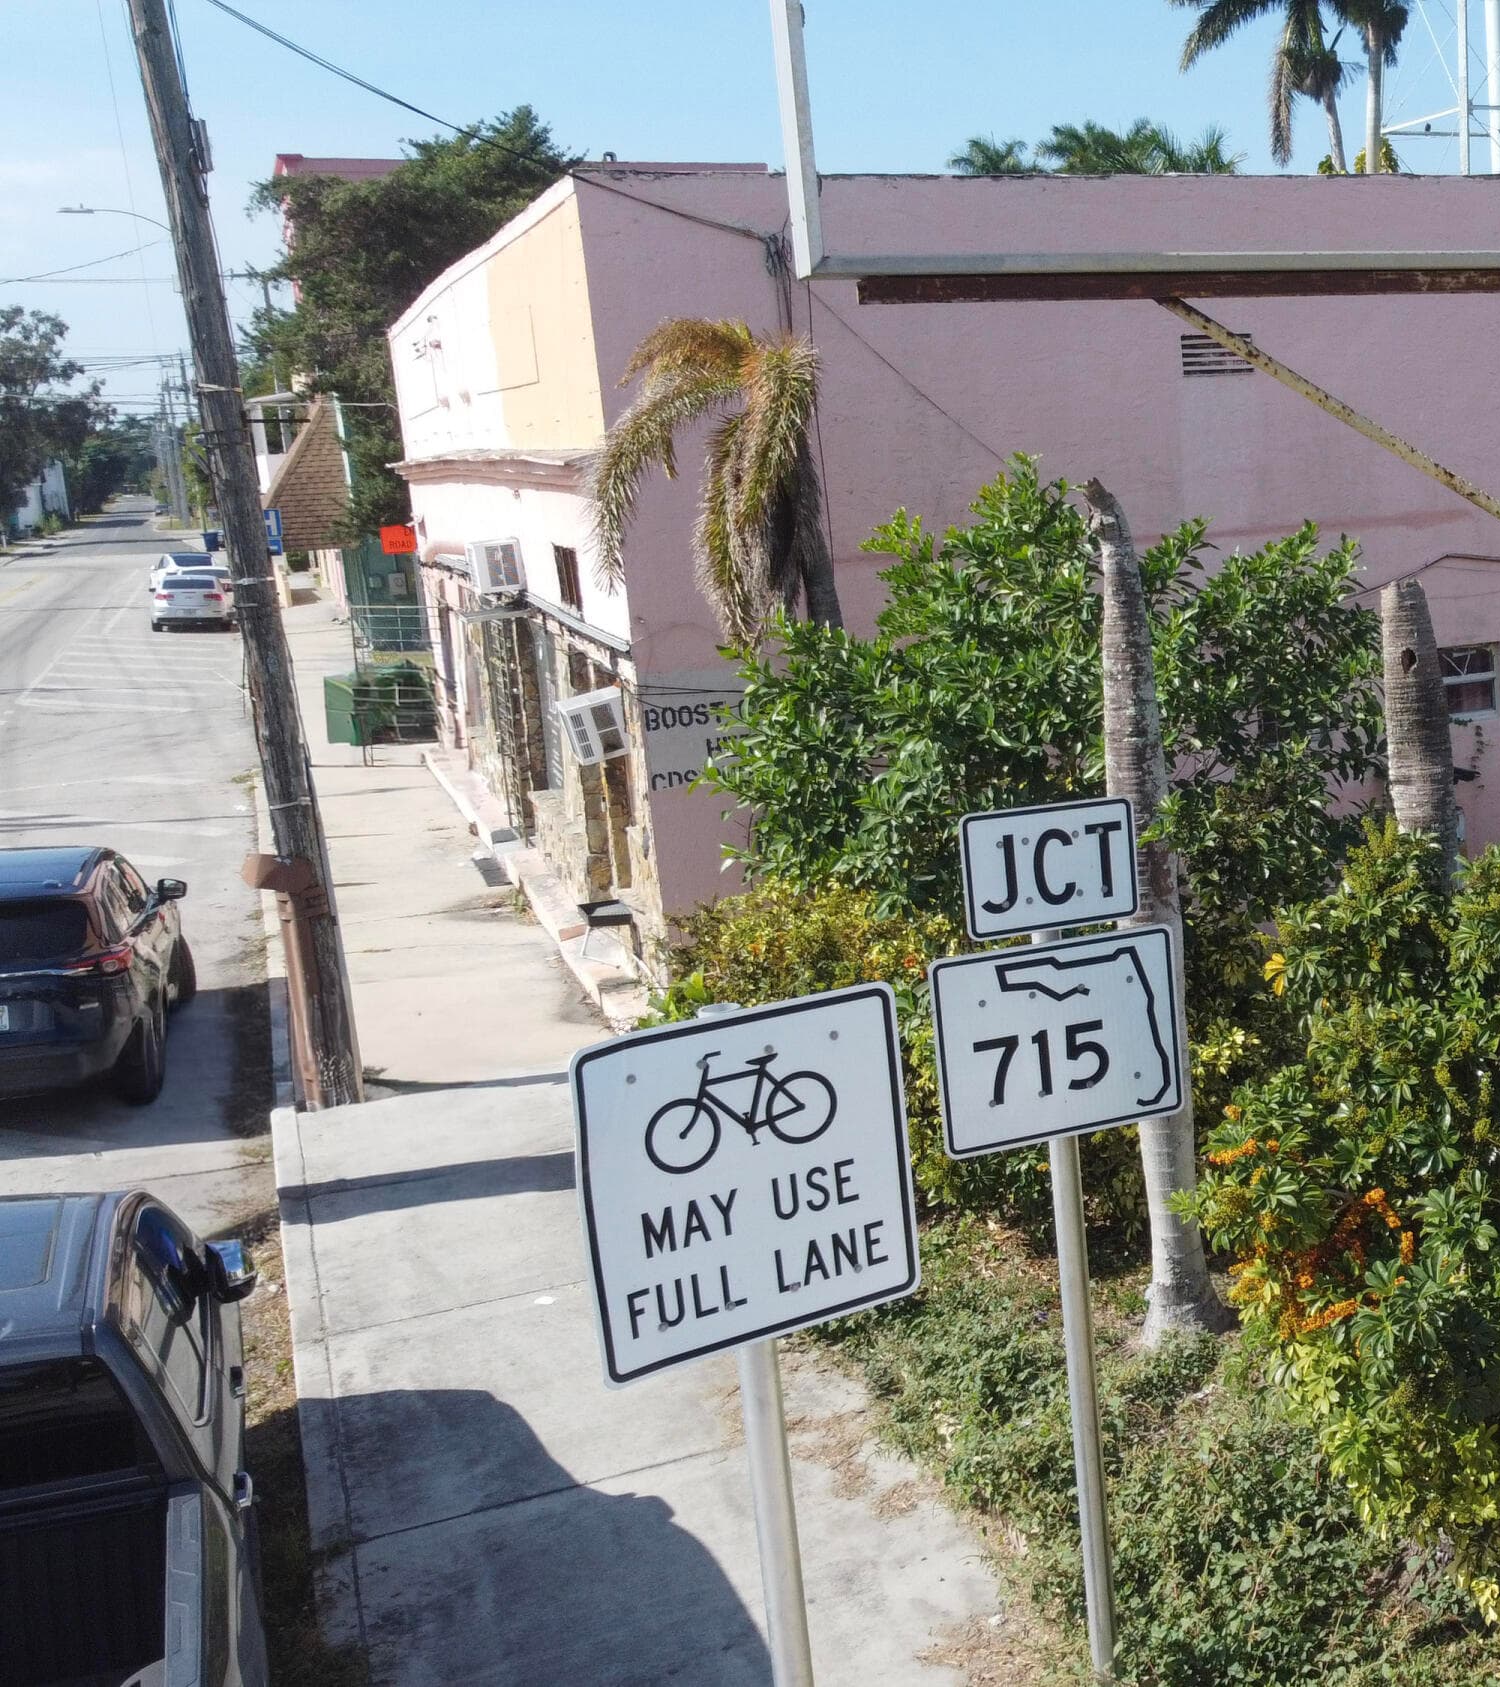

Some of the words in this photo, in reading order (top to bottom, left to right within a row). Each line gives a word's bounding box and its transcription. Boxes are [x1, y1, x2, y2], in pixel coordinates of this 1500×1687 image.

[389, 540, 412, 550] ROAD
[645, 701, 725, 732] BOOST
[981, 820, 1121, 915] JCT
[973, 1020, 1110, 1106] 715
[641, 1188, 738, 1259] MAY
[772, 1158, 860, 1220] USE
[627, 1266, 748, 1340] FULL
[774, 1220, 889, 1294] LANE
